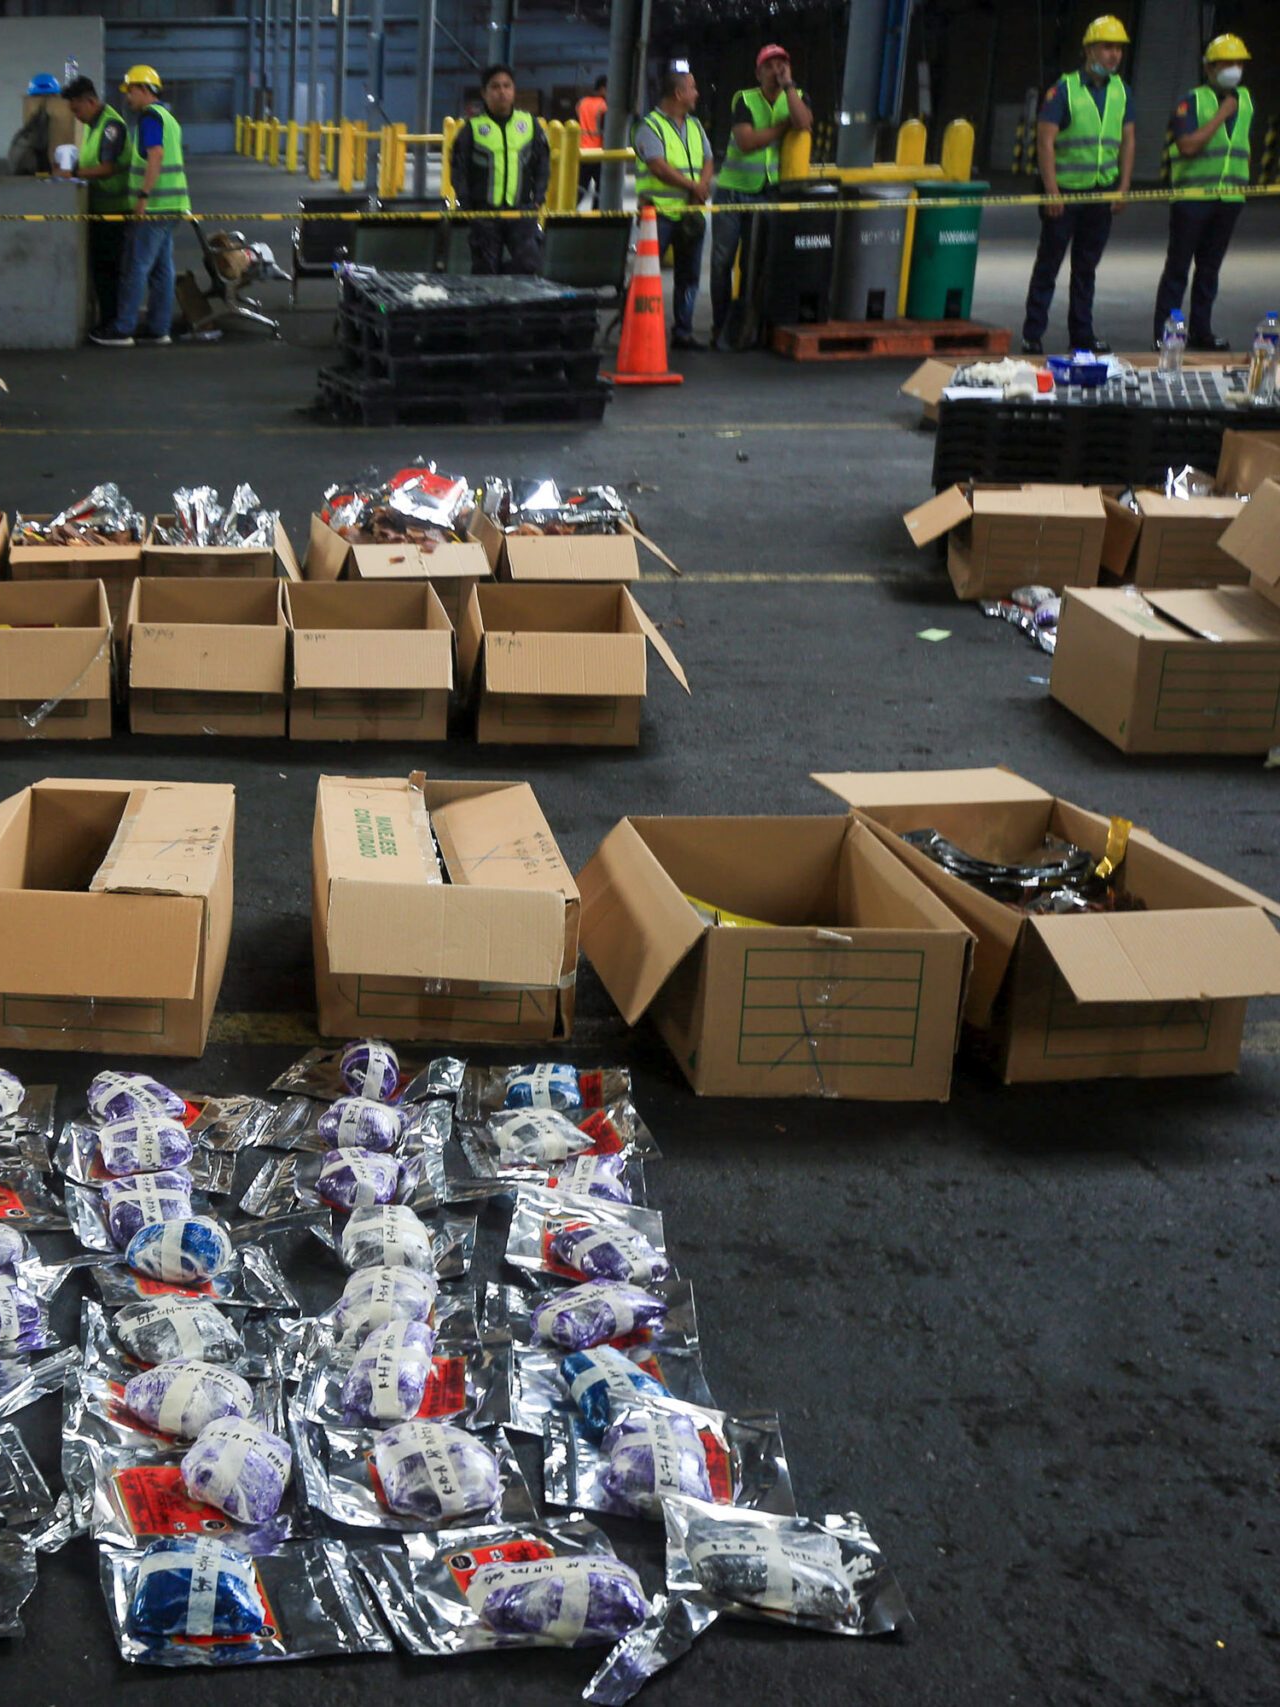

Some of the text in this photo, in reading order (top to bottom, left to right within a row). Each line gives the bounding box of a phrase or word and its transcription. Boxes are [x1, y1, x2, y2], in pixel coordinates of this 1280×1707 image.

[354, 808, 371, 823] CON
[356, 824, 377, 858] CUIDADO
[375, 816, 398, 856] MANEJESE
